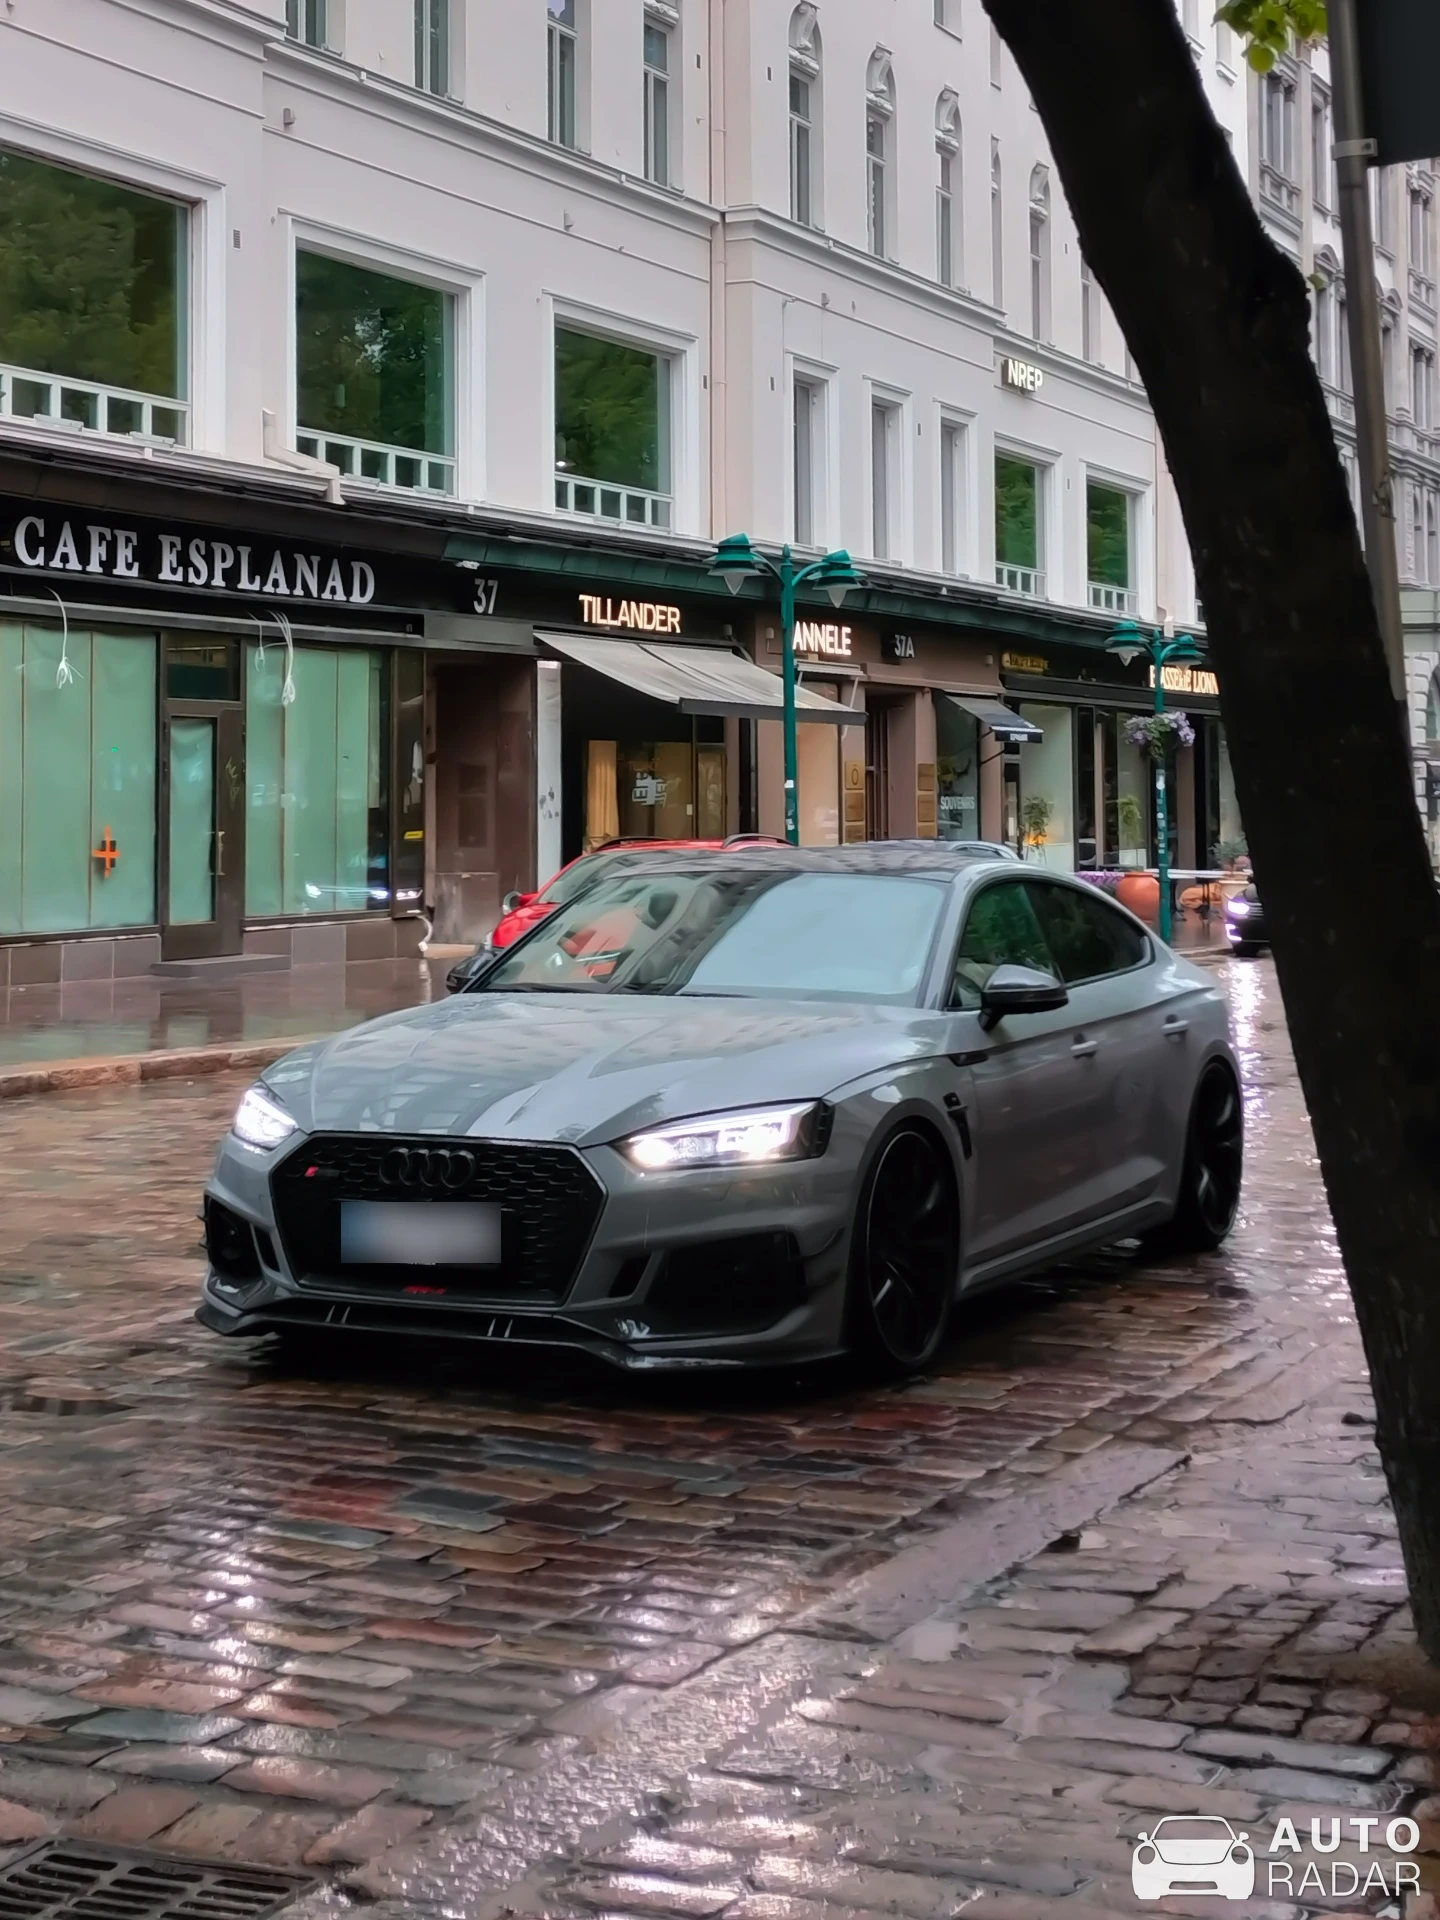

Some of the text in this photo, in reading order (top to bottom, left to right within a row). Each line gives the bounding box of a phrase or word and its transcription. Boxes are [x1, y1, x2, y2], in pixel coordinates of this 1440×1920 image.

[1007, 358, 1044, 392] NREP
[14, 516, 376, 604] CAFE ESPLANAD
[473, 578, 499, 615] 37
[578, 594, 682, 634] TILLANDER
[894, 633, 916, 659] 37A
